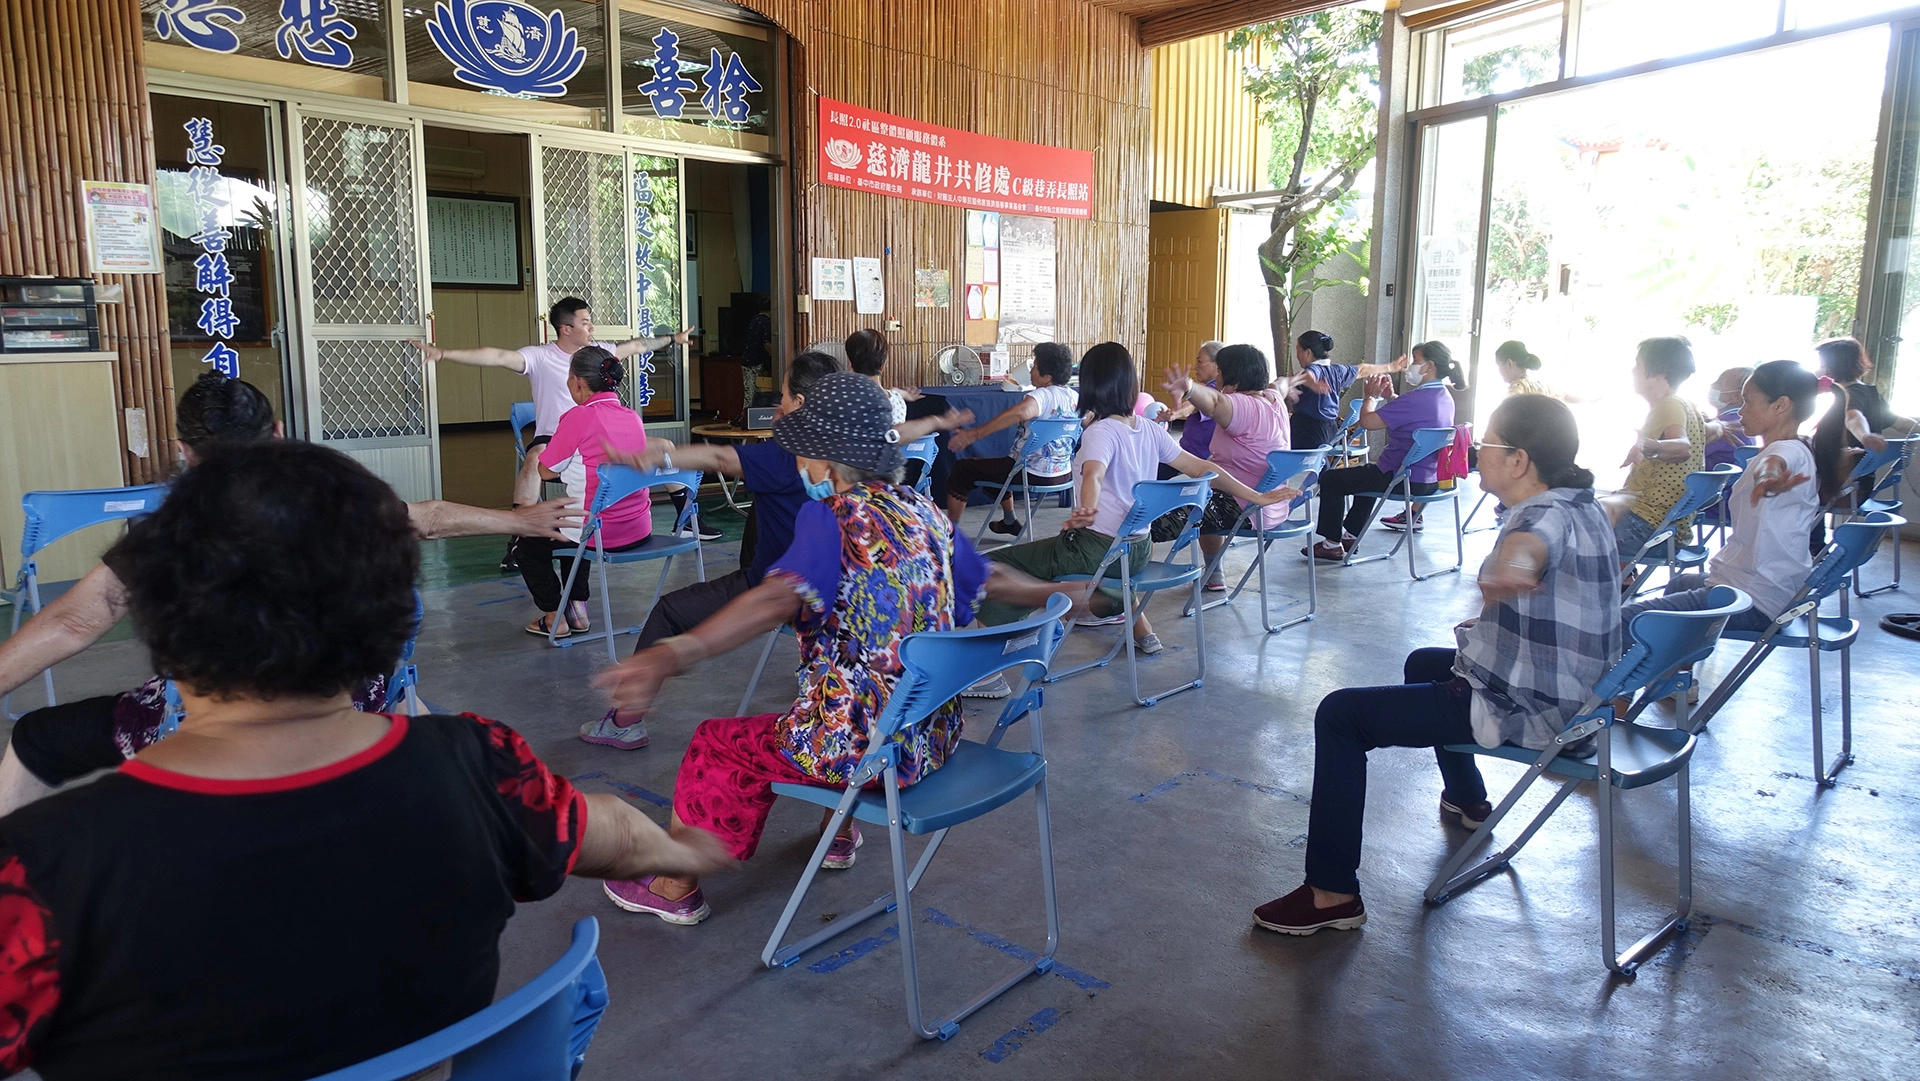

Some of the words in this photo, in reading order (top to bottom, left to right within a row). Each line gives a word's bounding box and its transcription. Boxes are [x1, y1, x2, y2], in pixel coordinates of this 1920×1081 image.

[524, 26, 545, 42] 濟
[637, 26, 763, 124] 喜捨
[830, 110, 946, 148] 長照2.0社區整體照顧服務體系
[866, 140, 1011, 197] 慈濟龍井共修處
[1013, 176, 1089, 202] C級巷弄長照站
